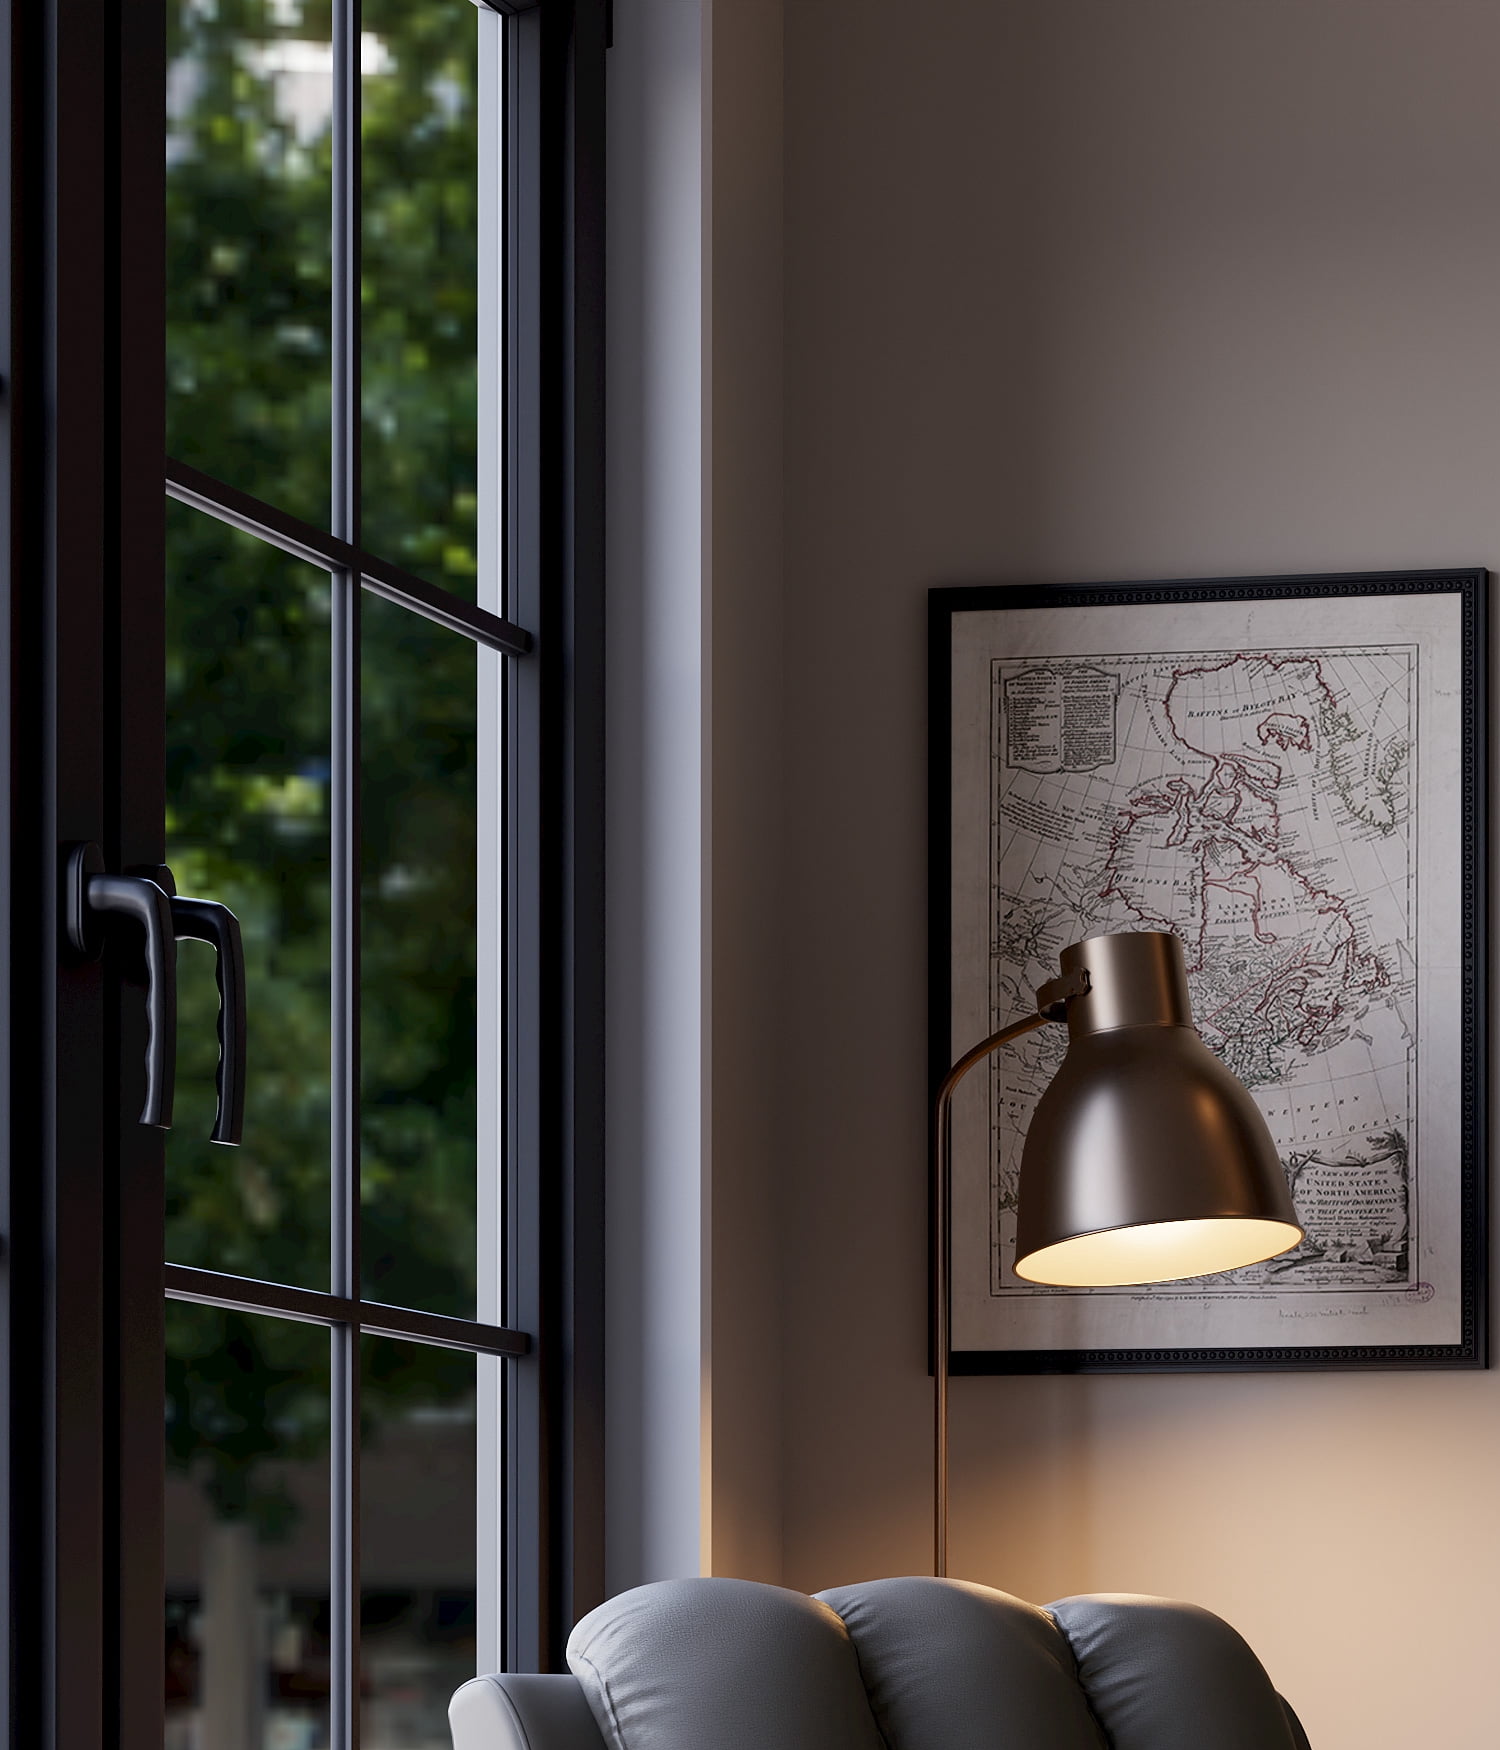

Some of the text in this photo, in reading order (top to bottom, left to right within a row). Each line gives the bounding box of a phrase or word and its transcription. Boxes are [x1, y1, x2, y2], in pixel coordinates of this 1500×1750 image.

[1306, 1178, 1389, 1188] UNITED STATES
[1316, 1188, 1350, 1197] NORTH
[1354, 1187, 1398, 1197] AMERICA
